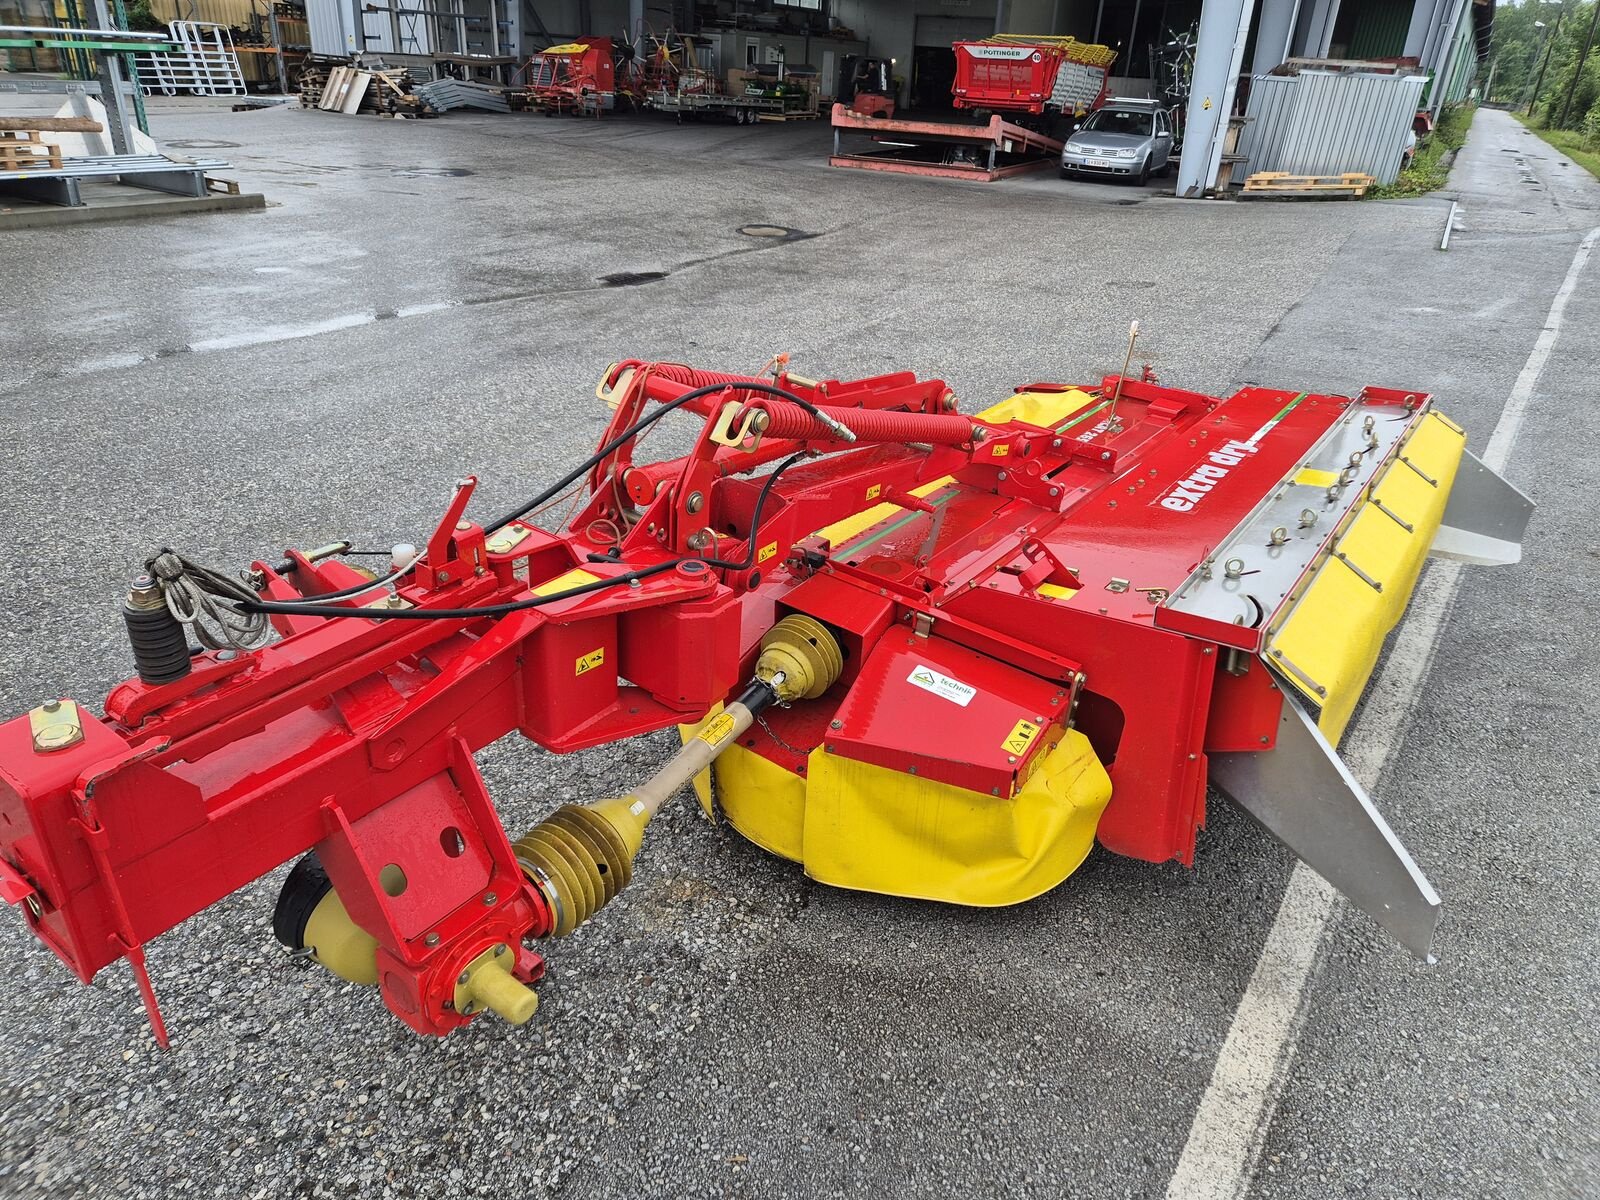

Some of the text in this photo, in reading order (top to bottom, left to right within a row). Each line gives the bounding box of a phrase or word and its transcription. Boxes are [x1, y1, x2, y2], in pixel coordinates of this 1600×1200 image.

[1160, 439, 1259, 512] extra dry
[940, 677, 972, 695] technik
